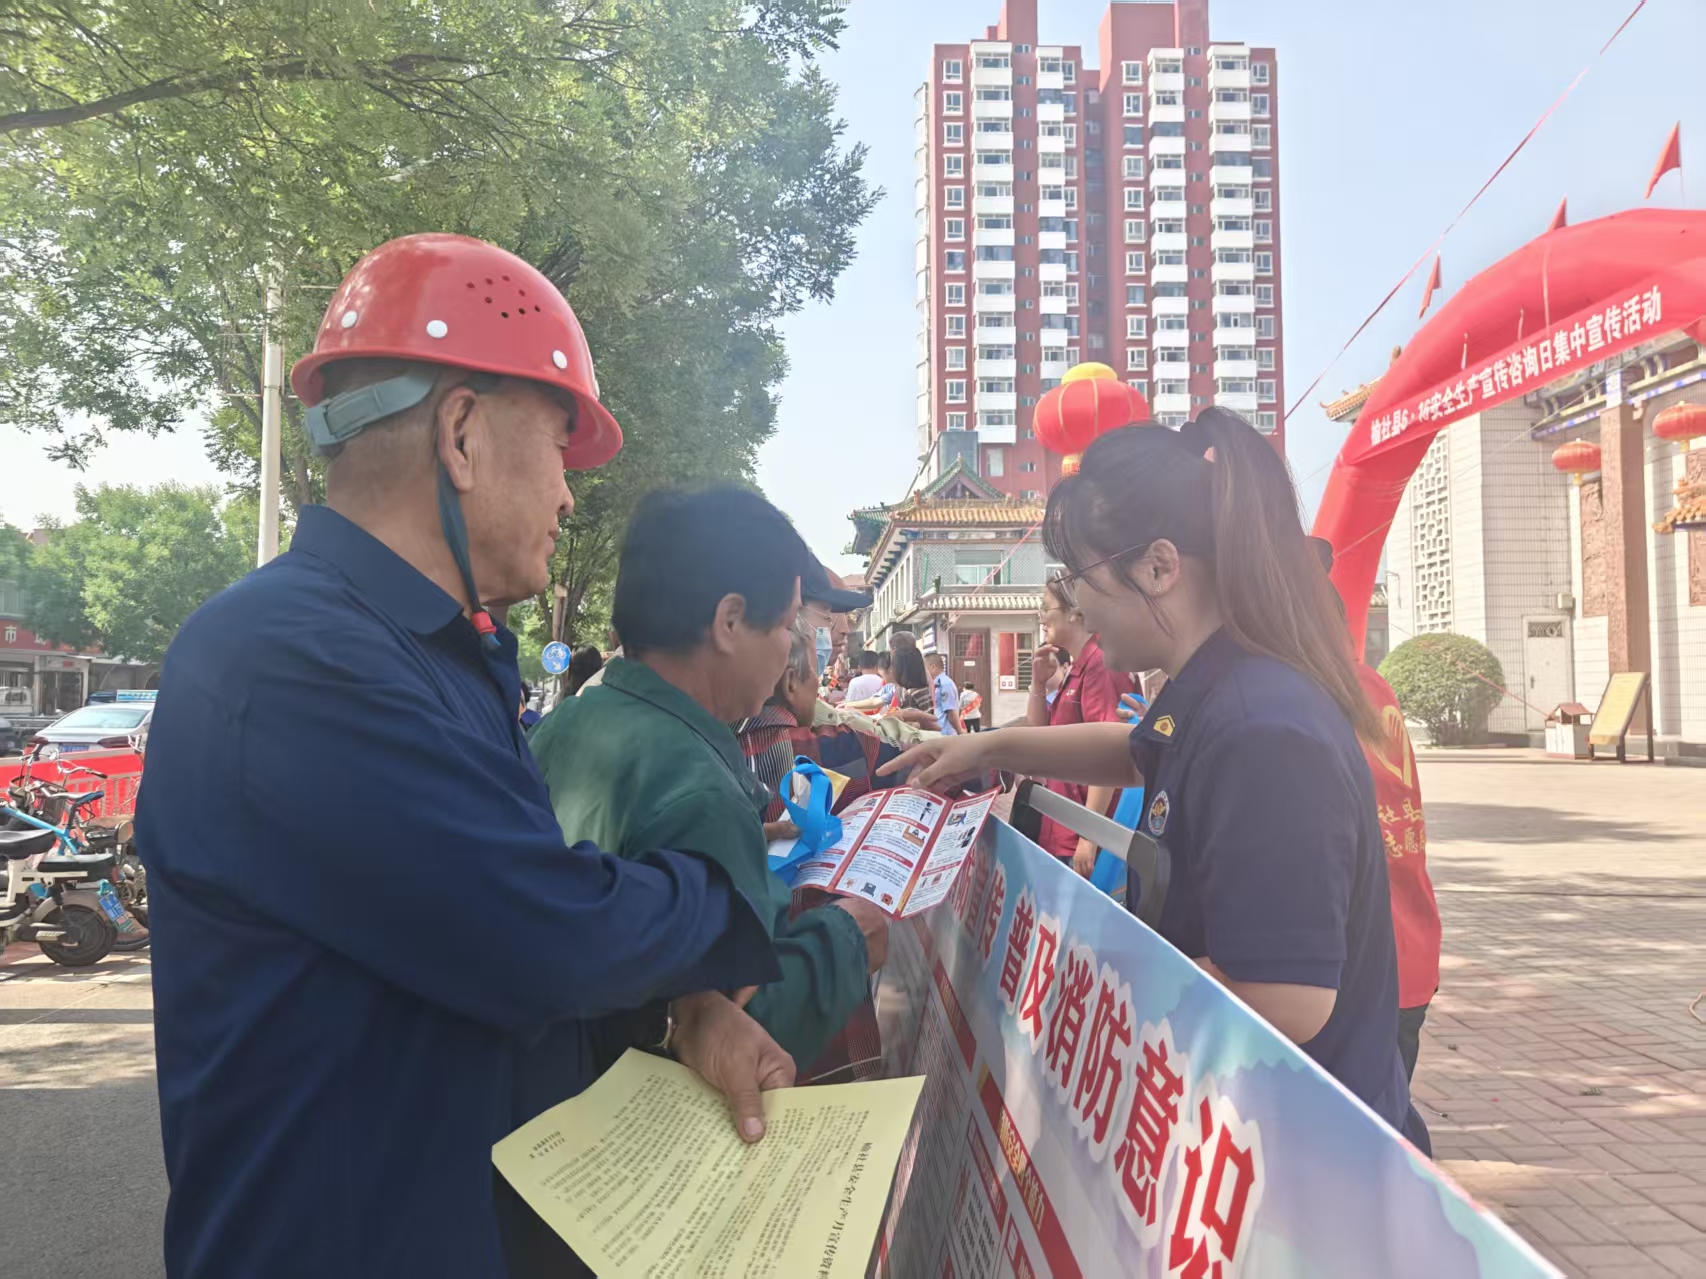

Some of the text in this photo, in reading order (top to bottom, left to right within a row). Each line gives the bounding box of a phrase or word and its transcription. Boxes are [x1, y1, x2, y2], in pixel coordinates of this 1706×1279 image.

[999, 894, 1257, 1279] 普及消防意识
